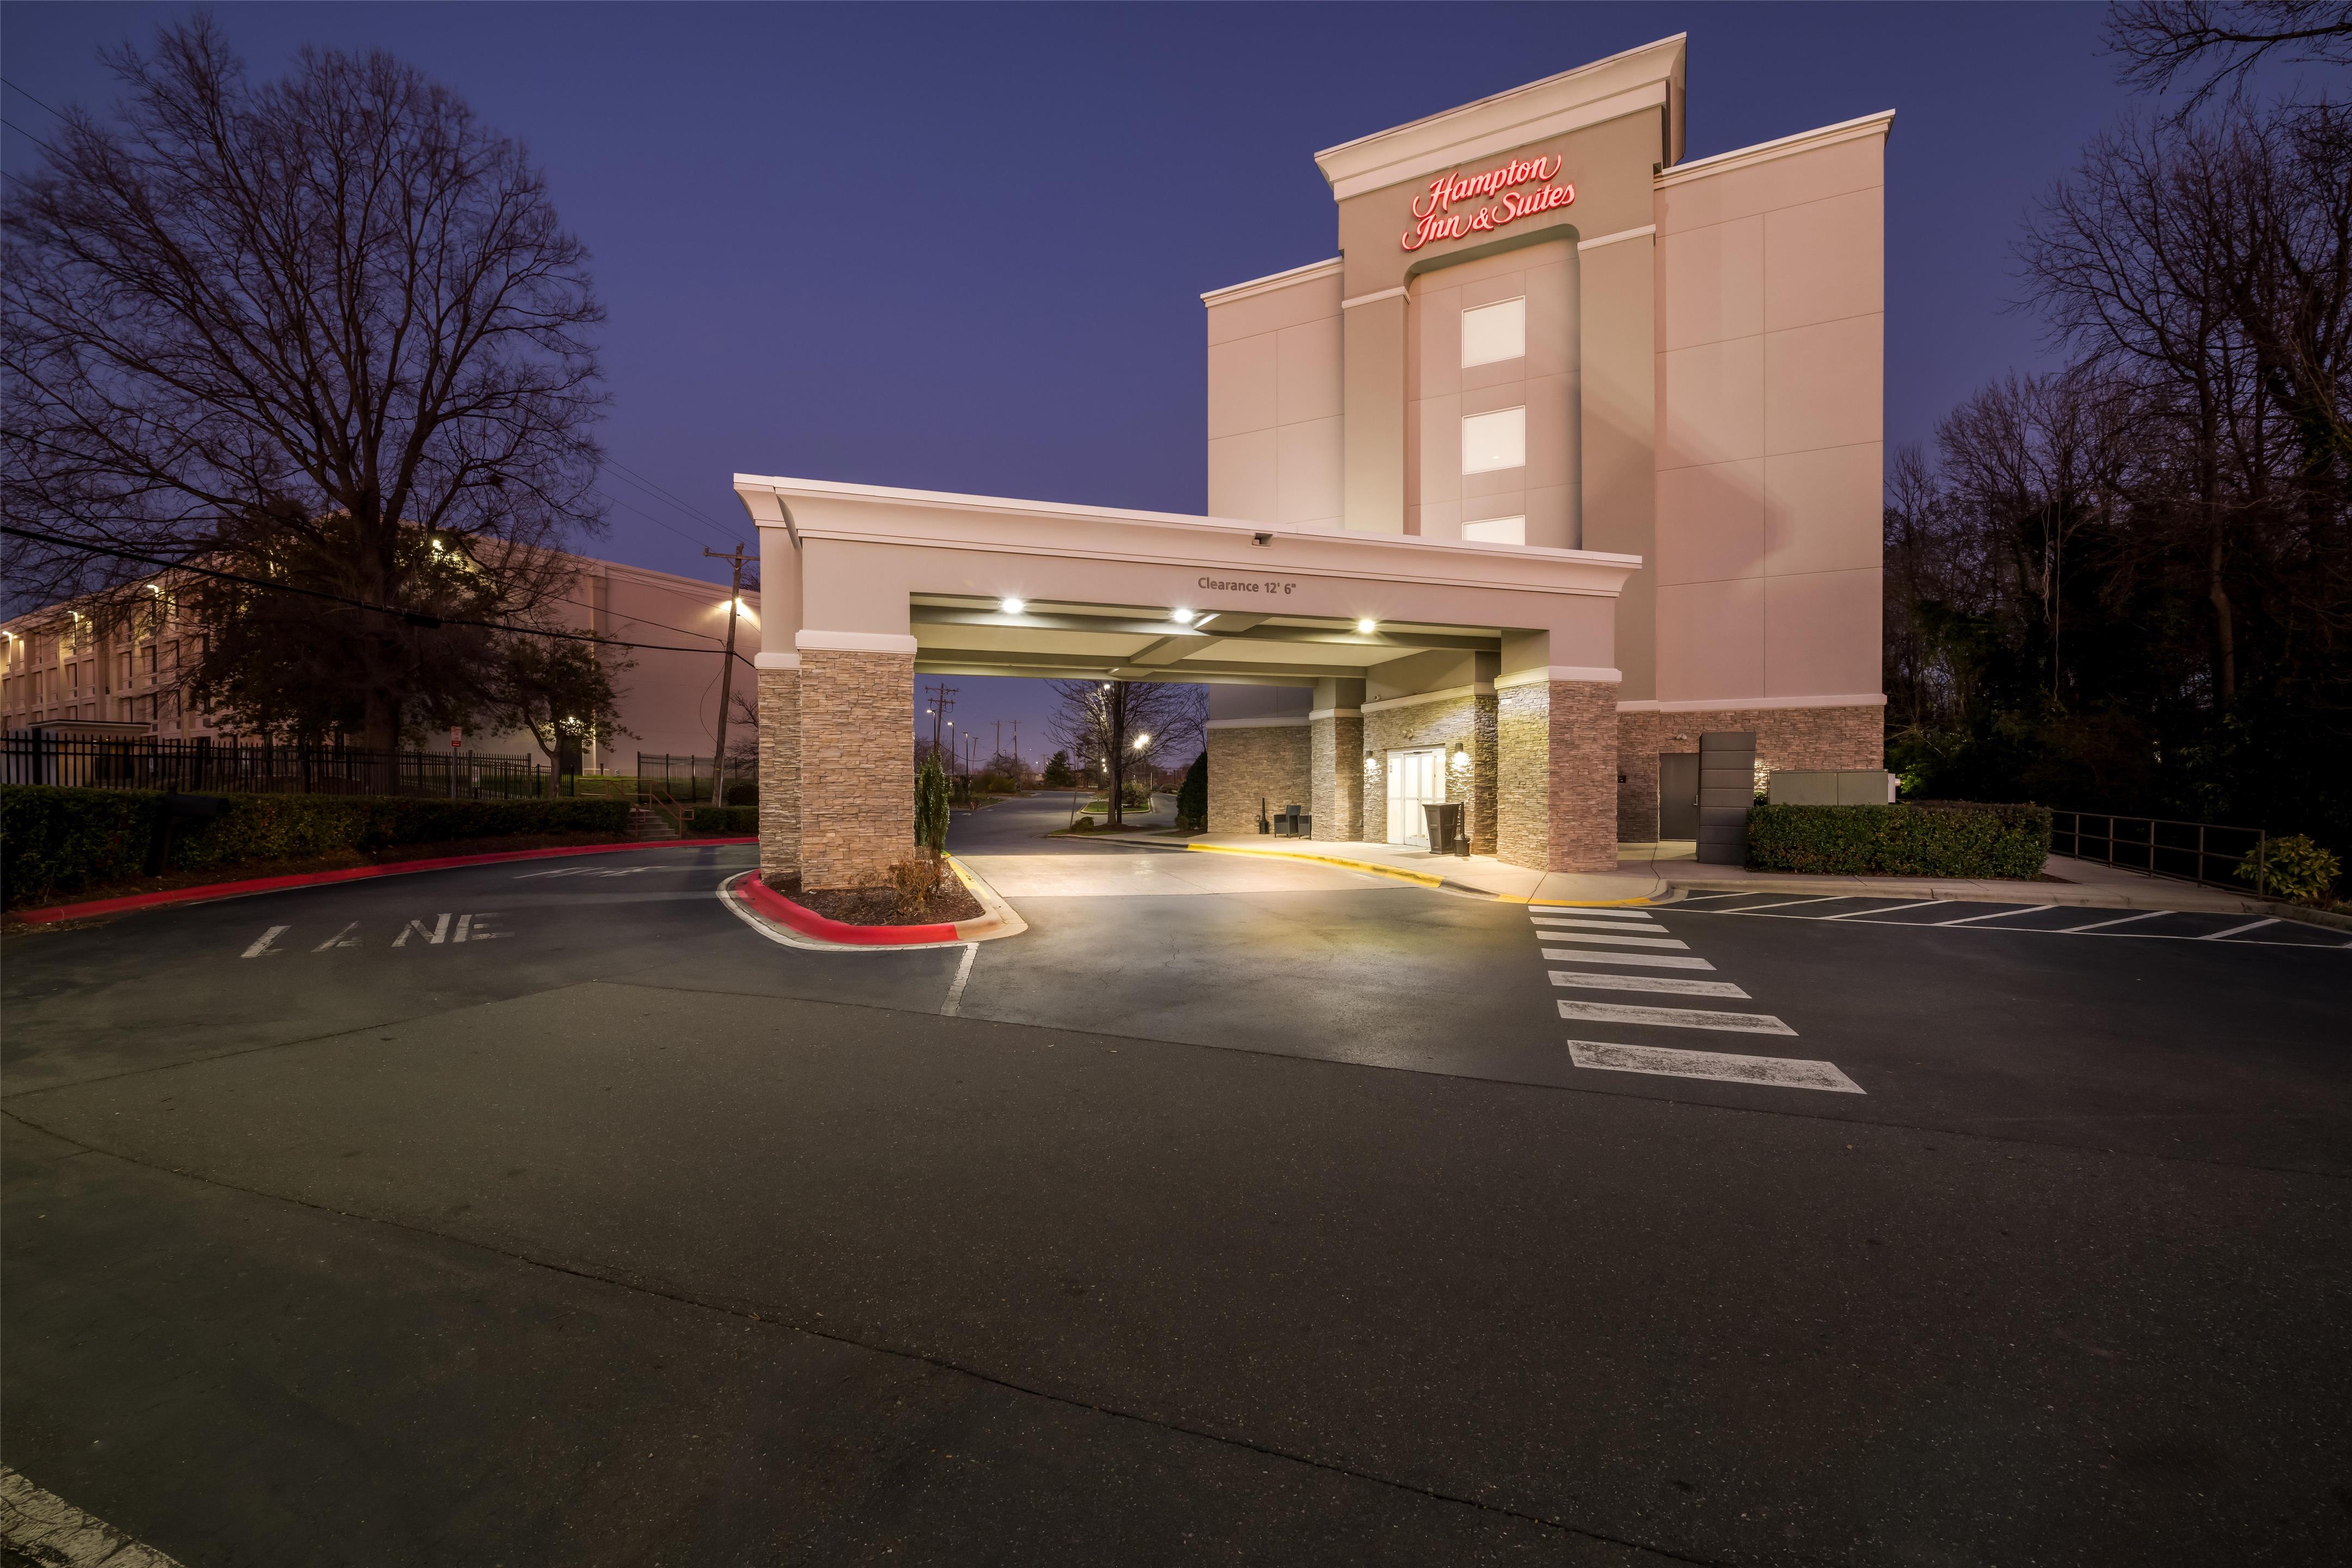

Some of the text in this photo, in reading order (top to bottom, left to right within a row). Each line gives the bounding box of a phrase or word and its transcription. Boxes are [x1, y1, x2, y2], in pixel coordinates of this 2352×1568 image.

[1401, 184, 1575, 251] Inn & Suites
[1412, 154, 1562, 219] Hampton
[1198, 577, 1296, 595] Clearance 12' 6"
